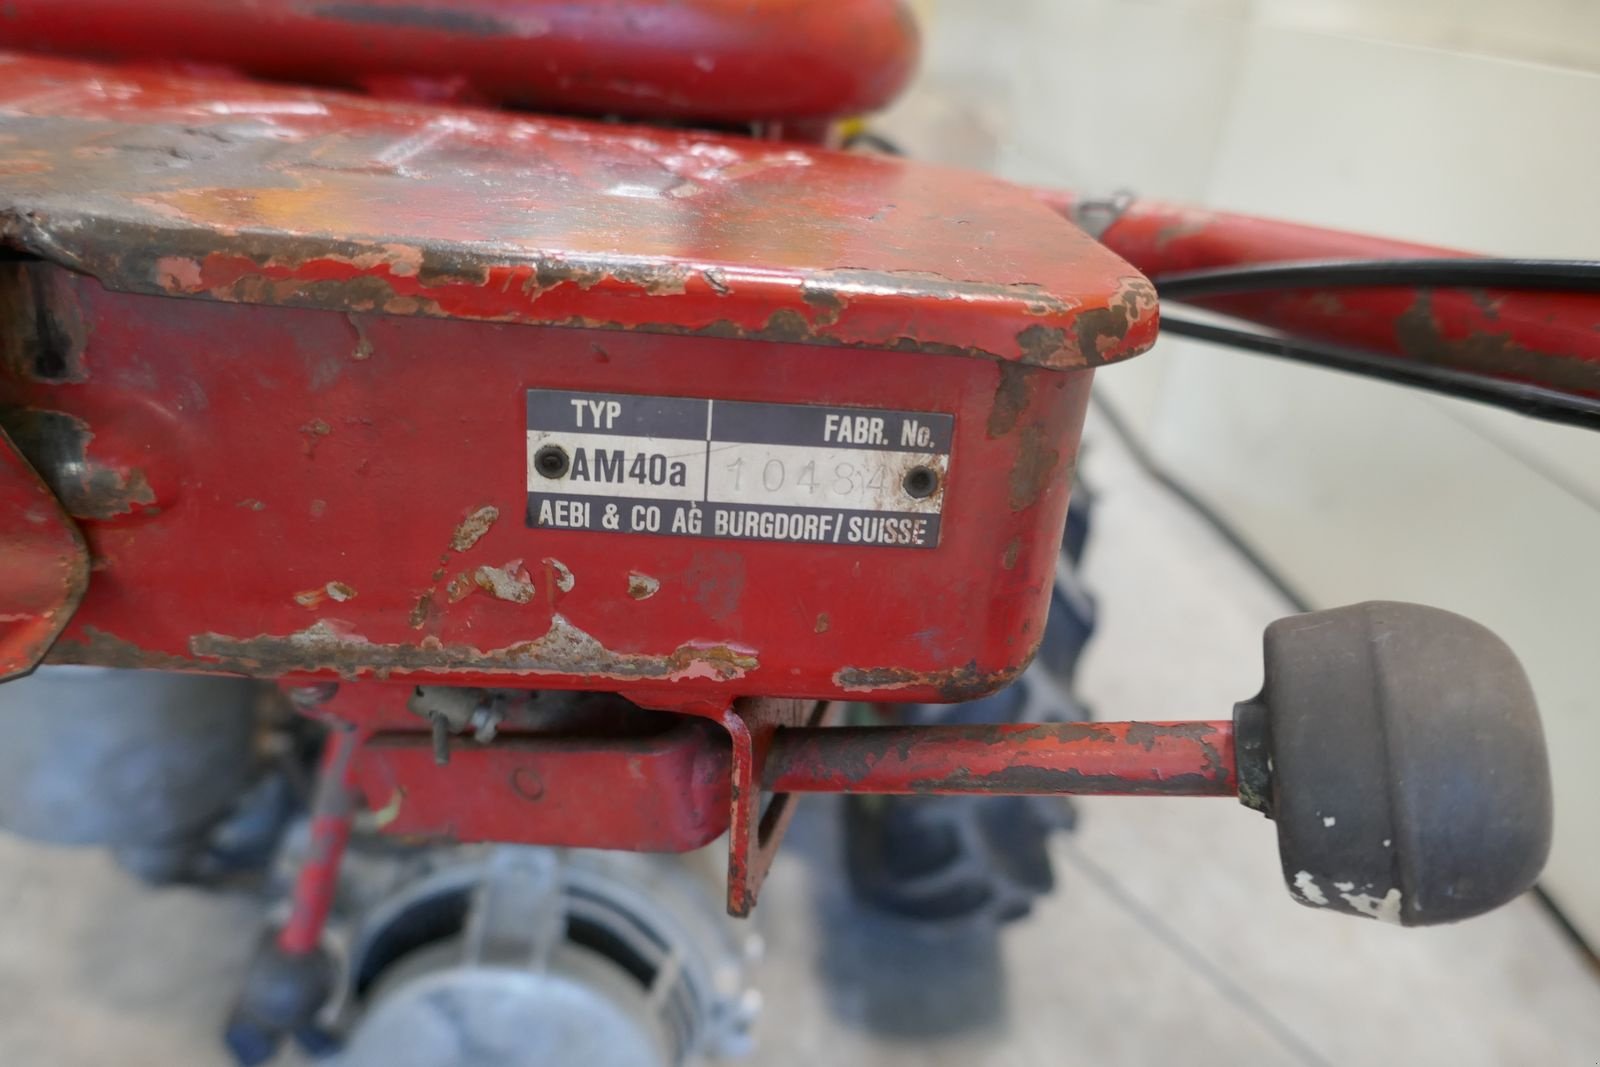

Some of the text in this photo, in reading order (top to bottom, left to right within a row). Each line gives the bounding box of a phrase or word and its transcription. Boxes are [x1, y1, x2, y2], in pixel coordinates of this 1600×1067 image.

[571, 399, 621, 430] TYP
[824, 414, 935, 449] FABR. No.
[570, 447, 687, 488] AM40a
[538, 502, 590, 529] AEBI
[602, 504, 620, 531] &
[631, 504, 660, 533] CO
[672, 505, 702, 535] AG
